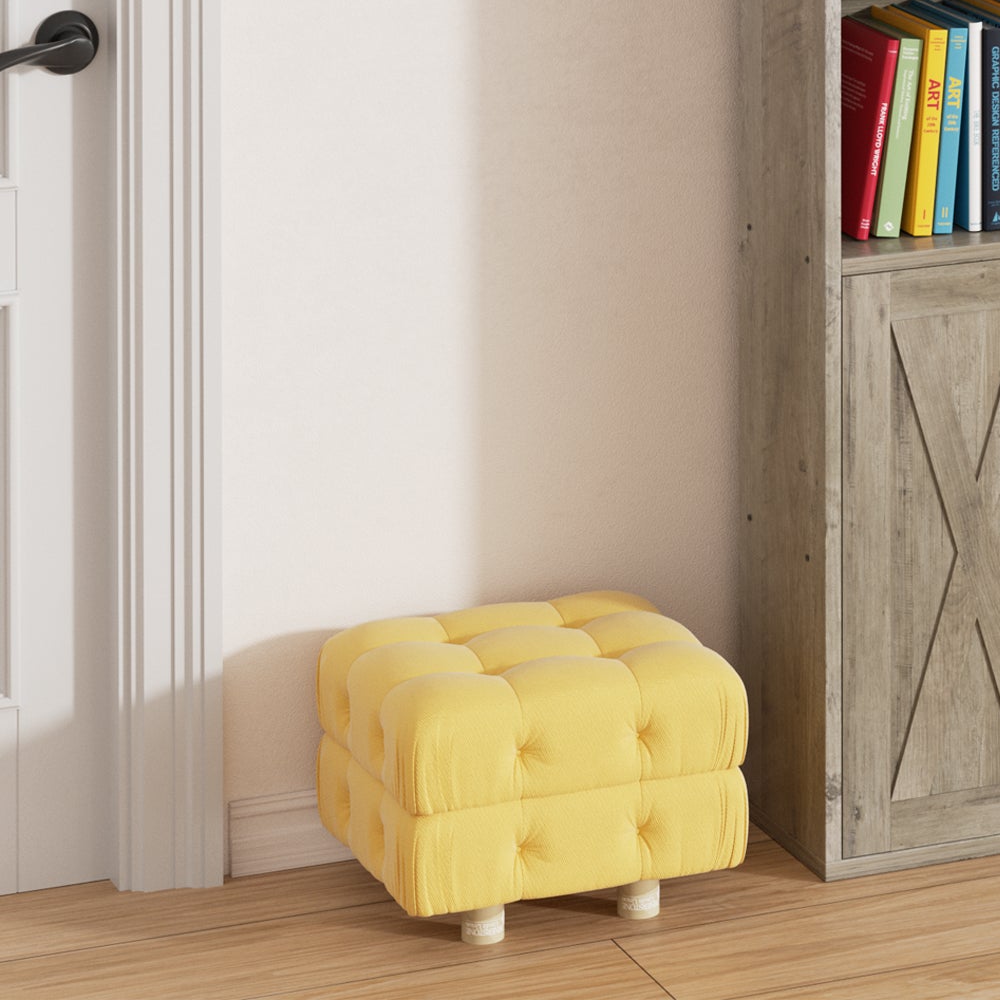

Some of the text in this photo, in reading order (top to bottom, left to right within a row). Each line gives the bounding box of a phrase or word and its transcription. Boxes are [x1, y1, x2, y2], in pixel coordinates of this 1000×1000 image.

[926, 78, 941, 110] ART
[947, 76, 962, 109] ART
[992, 46, 1000, 192] GRAPHIC DESIGN REFERENCED
[870, 102, 888, 176] FRANK LLOYD WRIGHT
